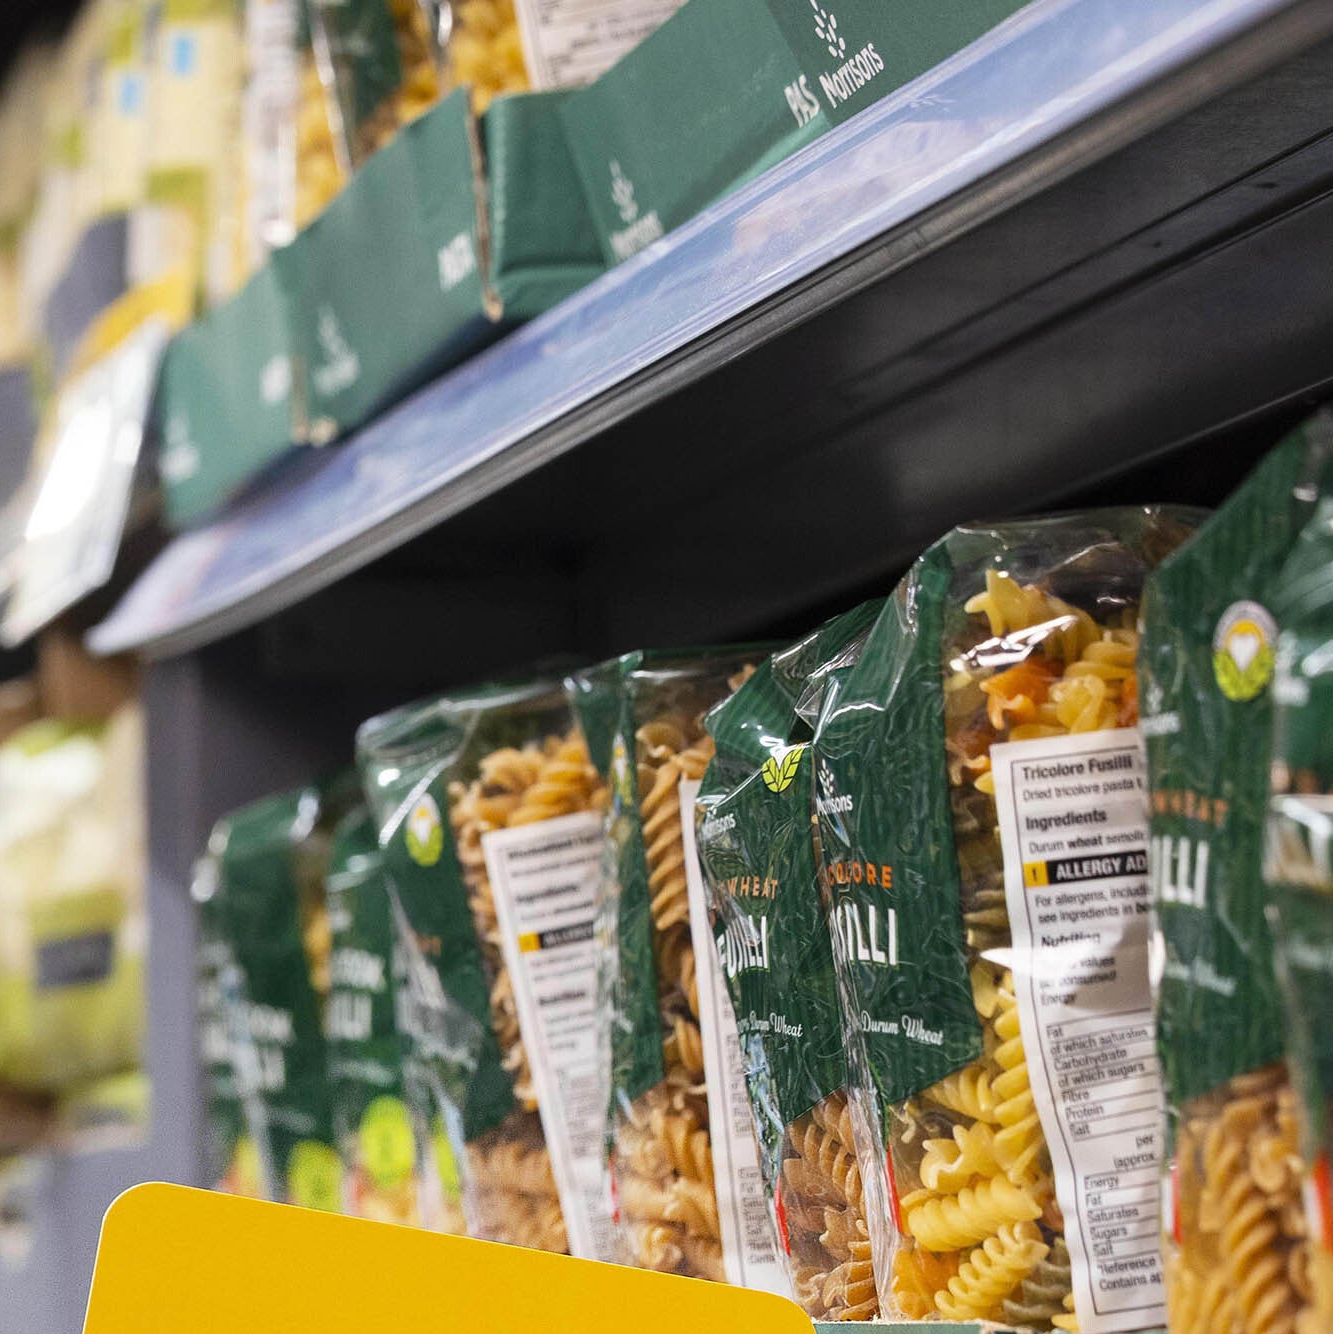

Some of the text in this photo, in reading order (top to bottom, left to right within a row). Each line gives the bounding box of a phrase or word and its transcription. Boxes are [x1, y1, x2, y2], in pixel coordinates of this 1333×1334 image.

[819, 43, 884, 109] Morrisons
[784, 74, 820, 128] PAS
[1022, 755, 1133, 781] Tricolore Fusilli
[1103, 779, 1134, 795] pasta
[1026, 809, 1107, 832] Ingredients
[1067, 833, 1103, 848] wheat
[1056, 859, 1121, 880] ALLERGY
[1035, 894, 1051, 908] For
[1038, 913, 1057, 925] see
[1060, 905, 1119, 923] ingredients
[1122, 903, 1133, 914] in
[769, 1012, 803, 1037] Wheat
[860, 1010, 944, 1046] Durum Wheat
[1065, 1037, 1097, 1052] which
[1054, 1049, 1127, 1071] Carbohydrate
[1072, 1069, 1106, 1084] which
